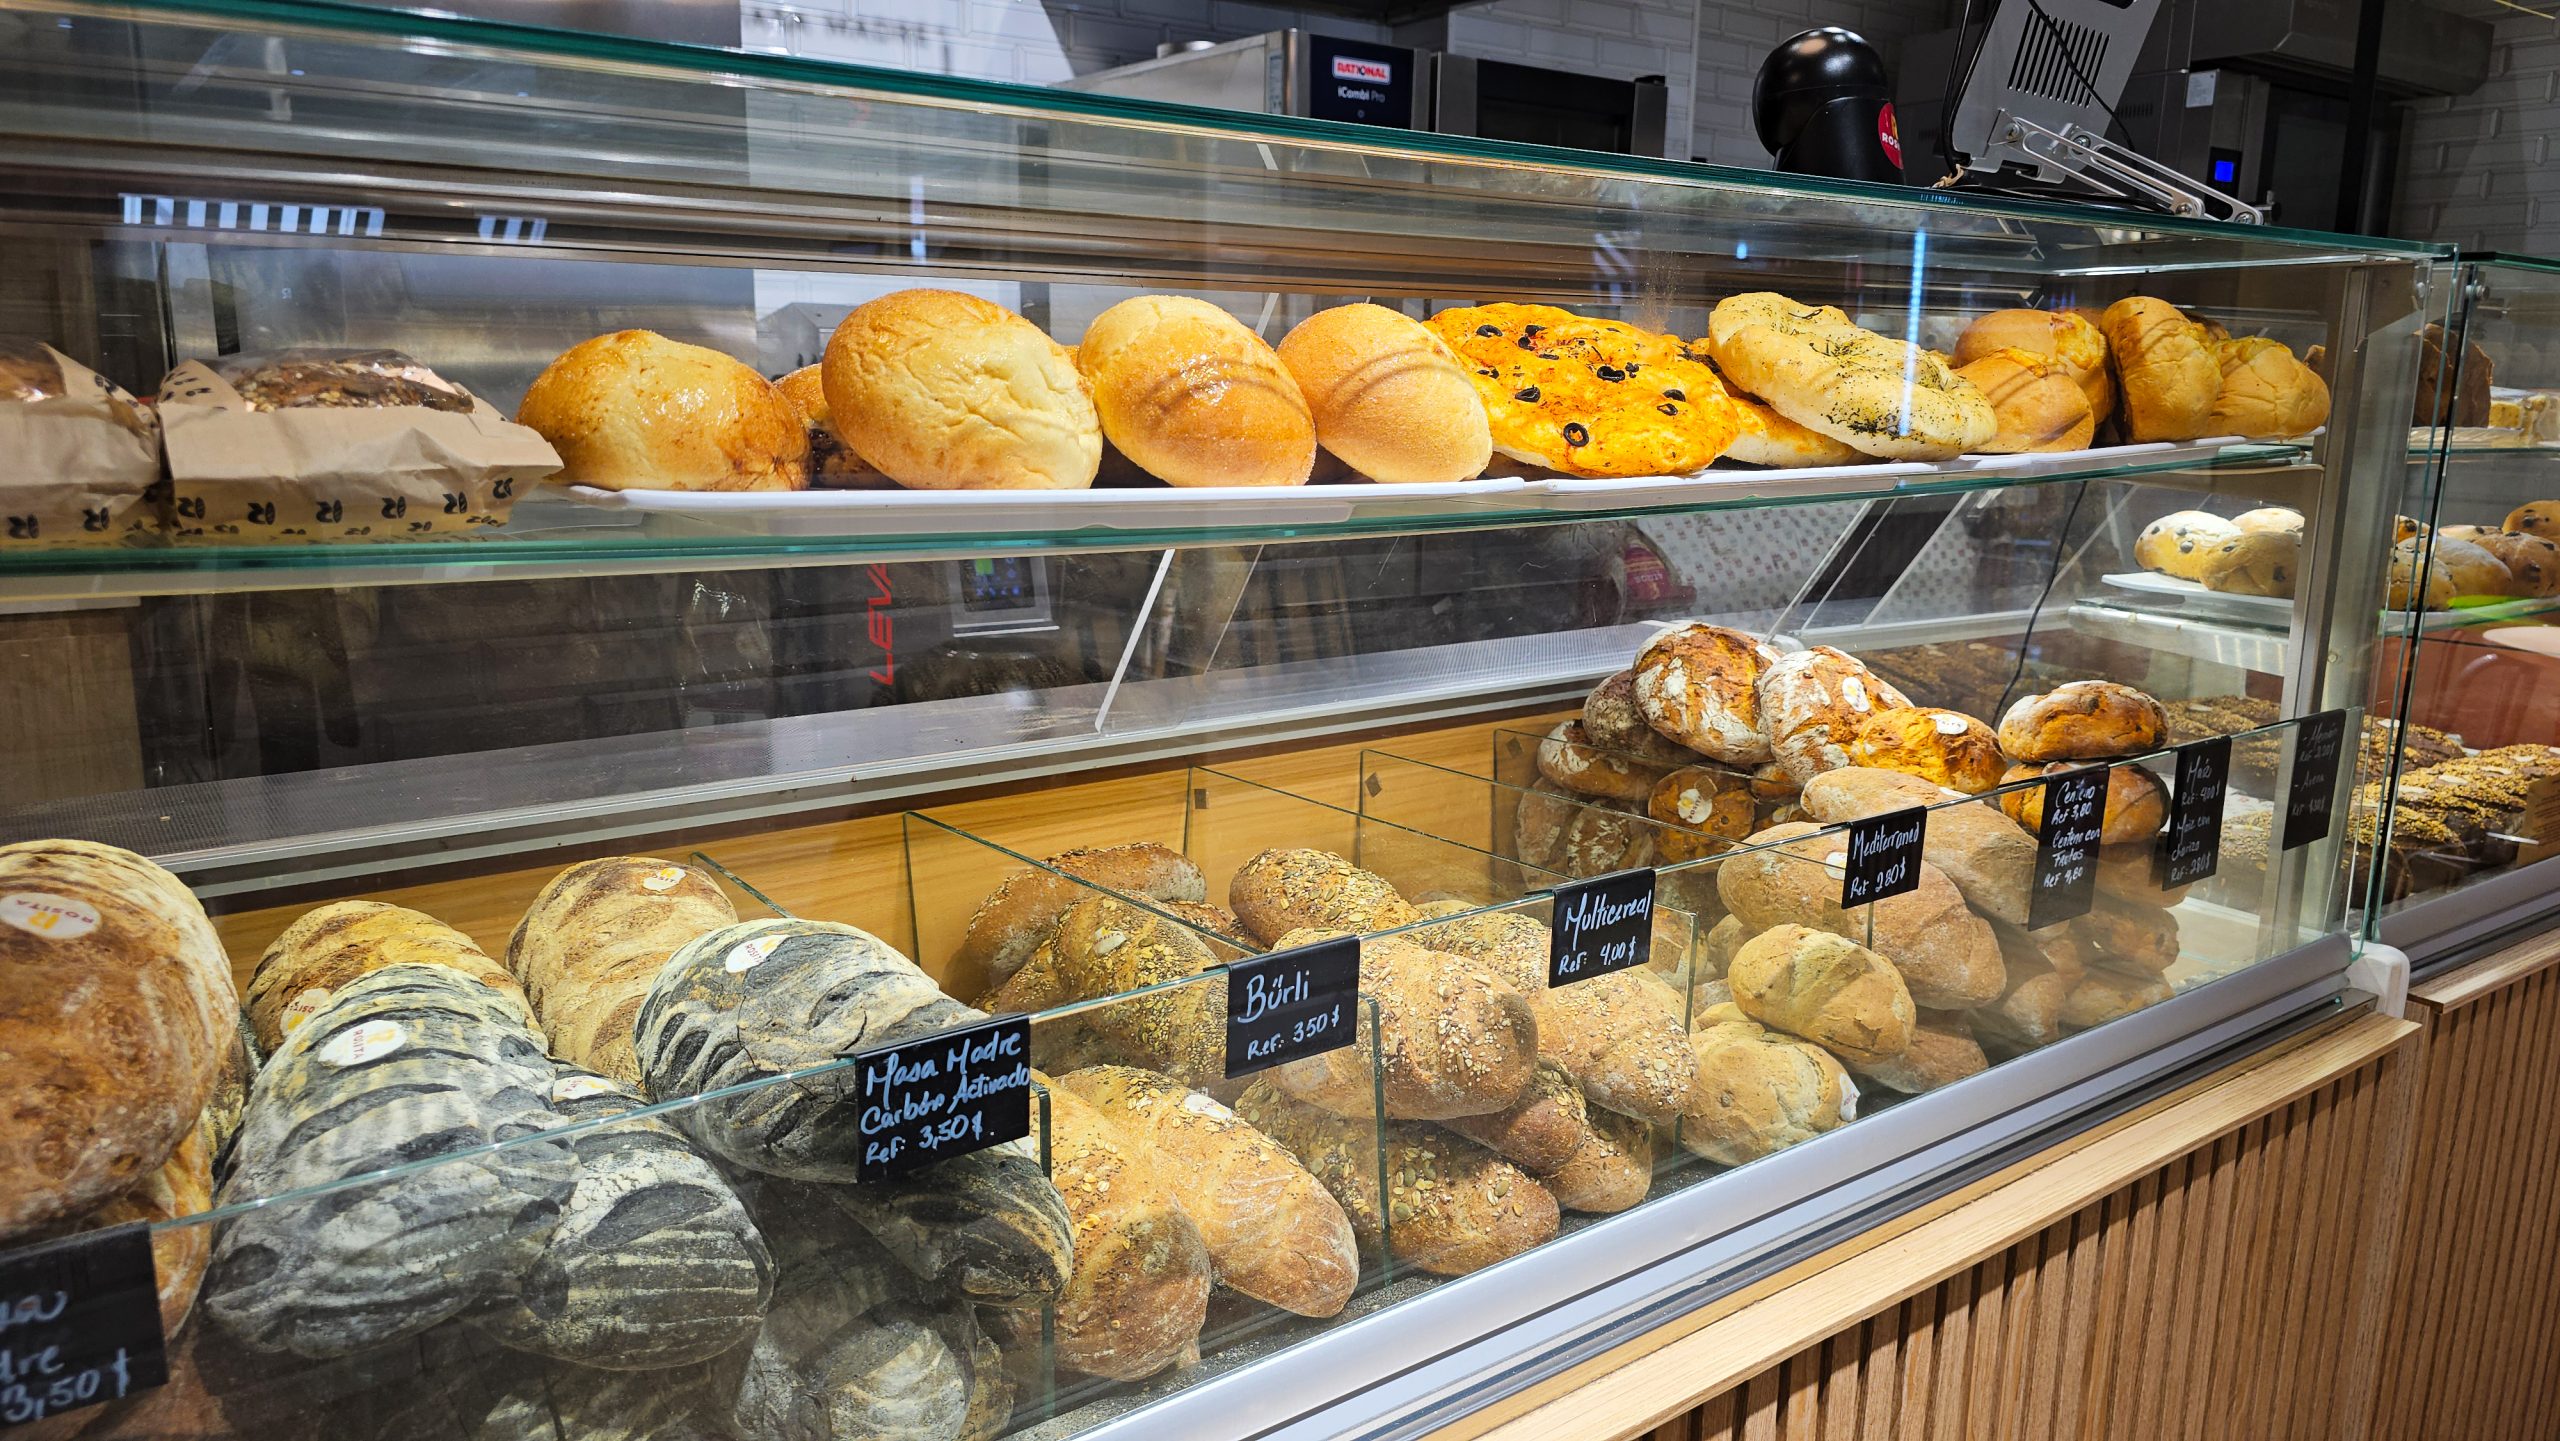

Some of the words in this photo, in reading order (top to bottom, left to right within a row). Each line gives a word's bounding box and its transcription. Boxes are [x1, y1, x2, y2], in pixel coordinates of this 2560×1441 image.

[1237, 969, 1310, 1024] Bürli
[866, 1052, 939, 1110] Masa
[946, 1030, 1022, 1076] Madre
[947, 1062, 1031, 1114] Activado
